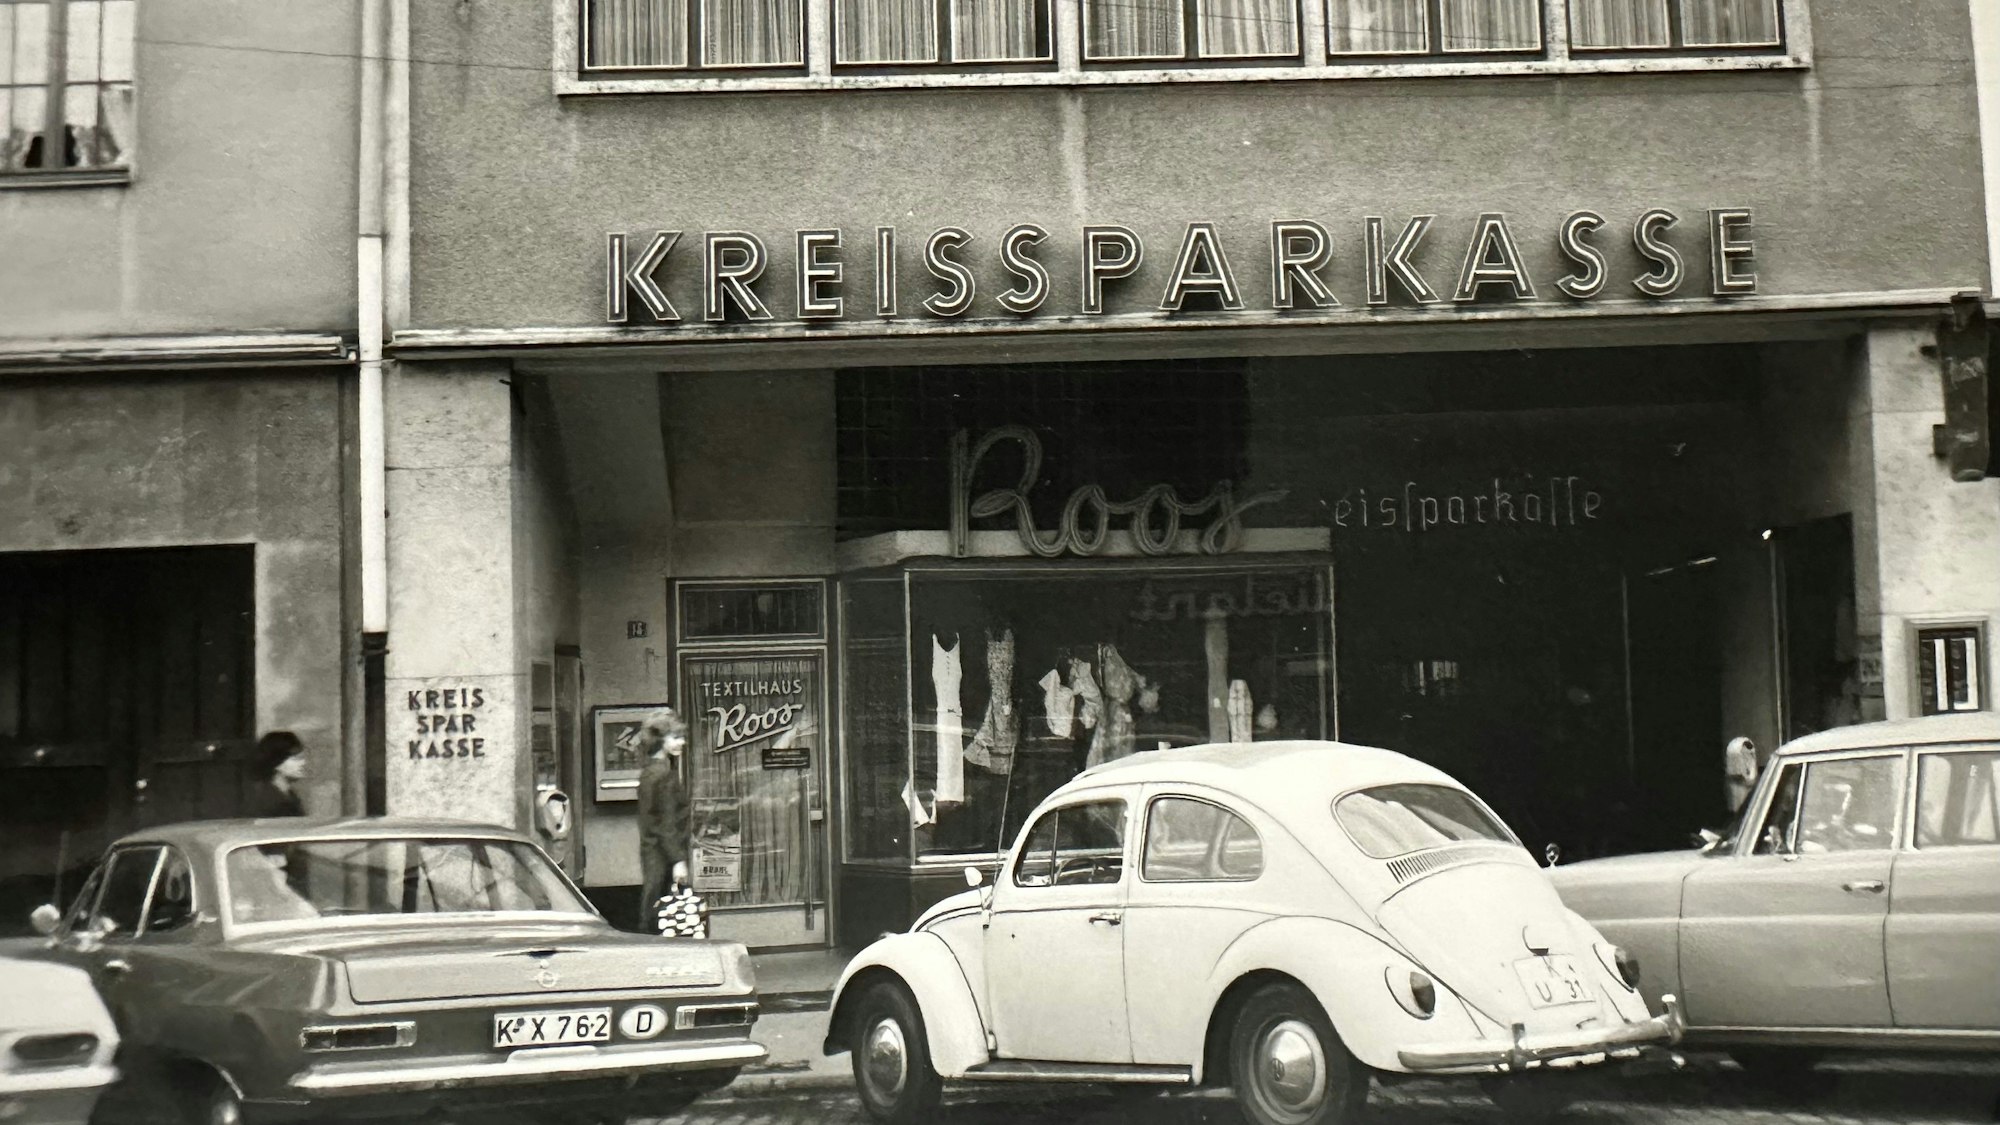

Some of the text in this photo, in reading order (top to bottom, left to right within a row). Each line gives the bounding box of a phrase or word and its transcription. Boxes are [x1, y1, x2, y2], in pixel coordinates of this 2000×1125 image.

[607, 208, 1758, 322] KREISSPARKASSE
[950, 424, 1290, 558] Roos
[700, 678, 802, 697] TEXTILHAUS
[408, 688, 484, 710] KREIS
[417, 714, 476, 734] SPAR
[707, 702, 803, 748] Roos
[408, 738, 485, 759] KASSE
[636, 1011, 653, 1033] D
